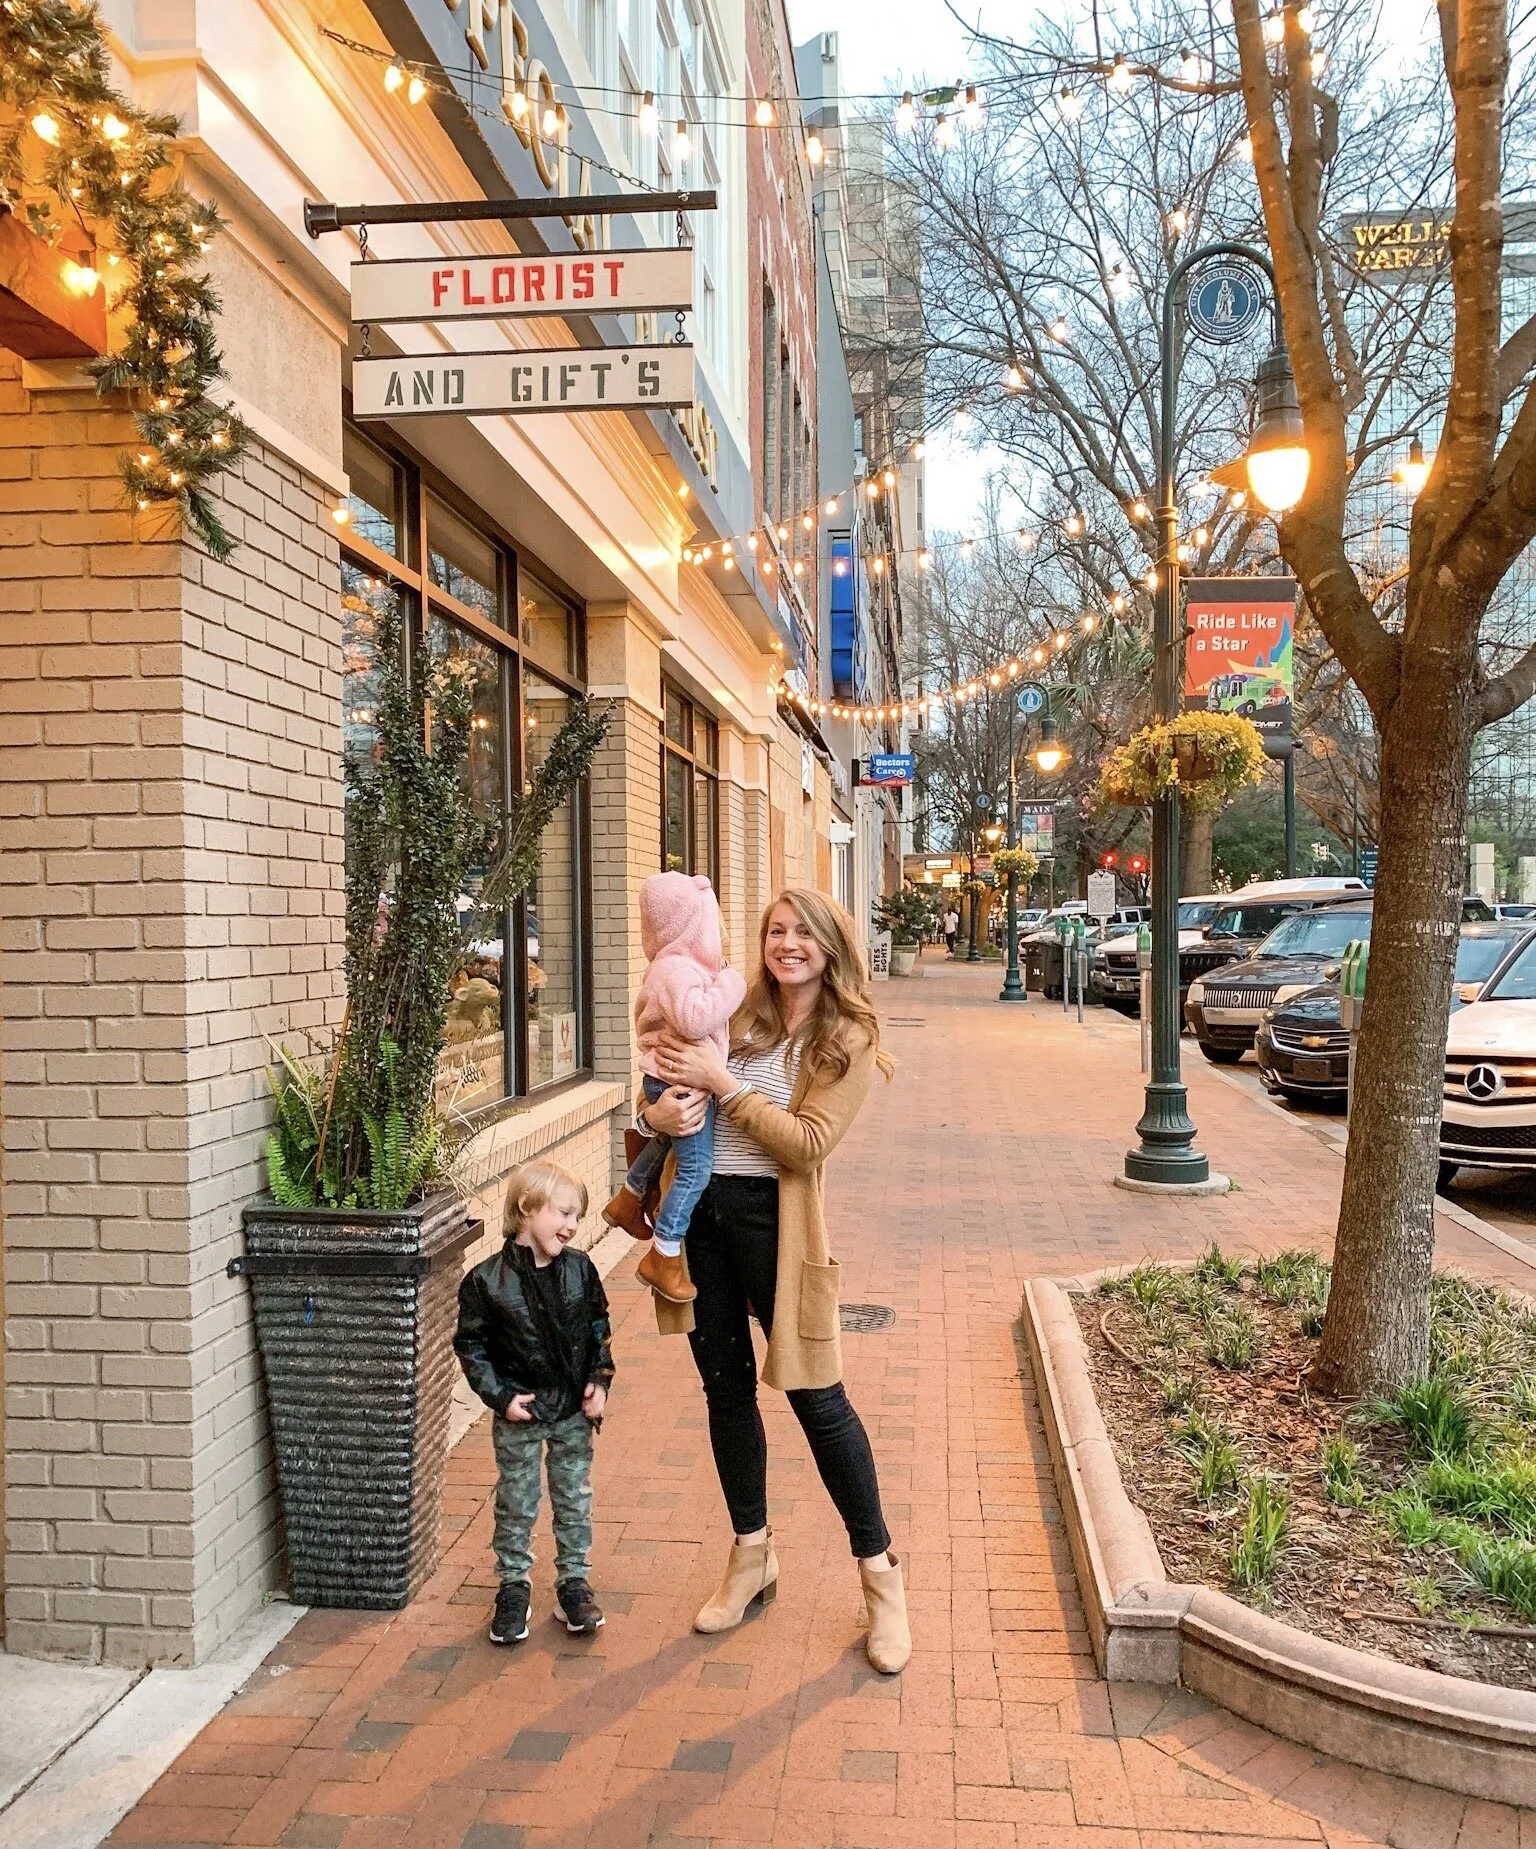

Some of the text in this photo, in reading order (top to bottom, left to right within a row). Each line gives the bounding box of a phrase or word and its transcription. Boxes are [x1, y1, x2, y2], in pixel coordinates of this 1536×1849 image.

[433, 261, 625, 307] FLORIST
[384, 354, 660, 407] AND GIFT'S
[1197, 614, 1278, 630] Ride Like
[1196, 635, 1249, 652] a Star
[1023, 805, 1051, 813] MAIN
